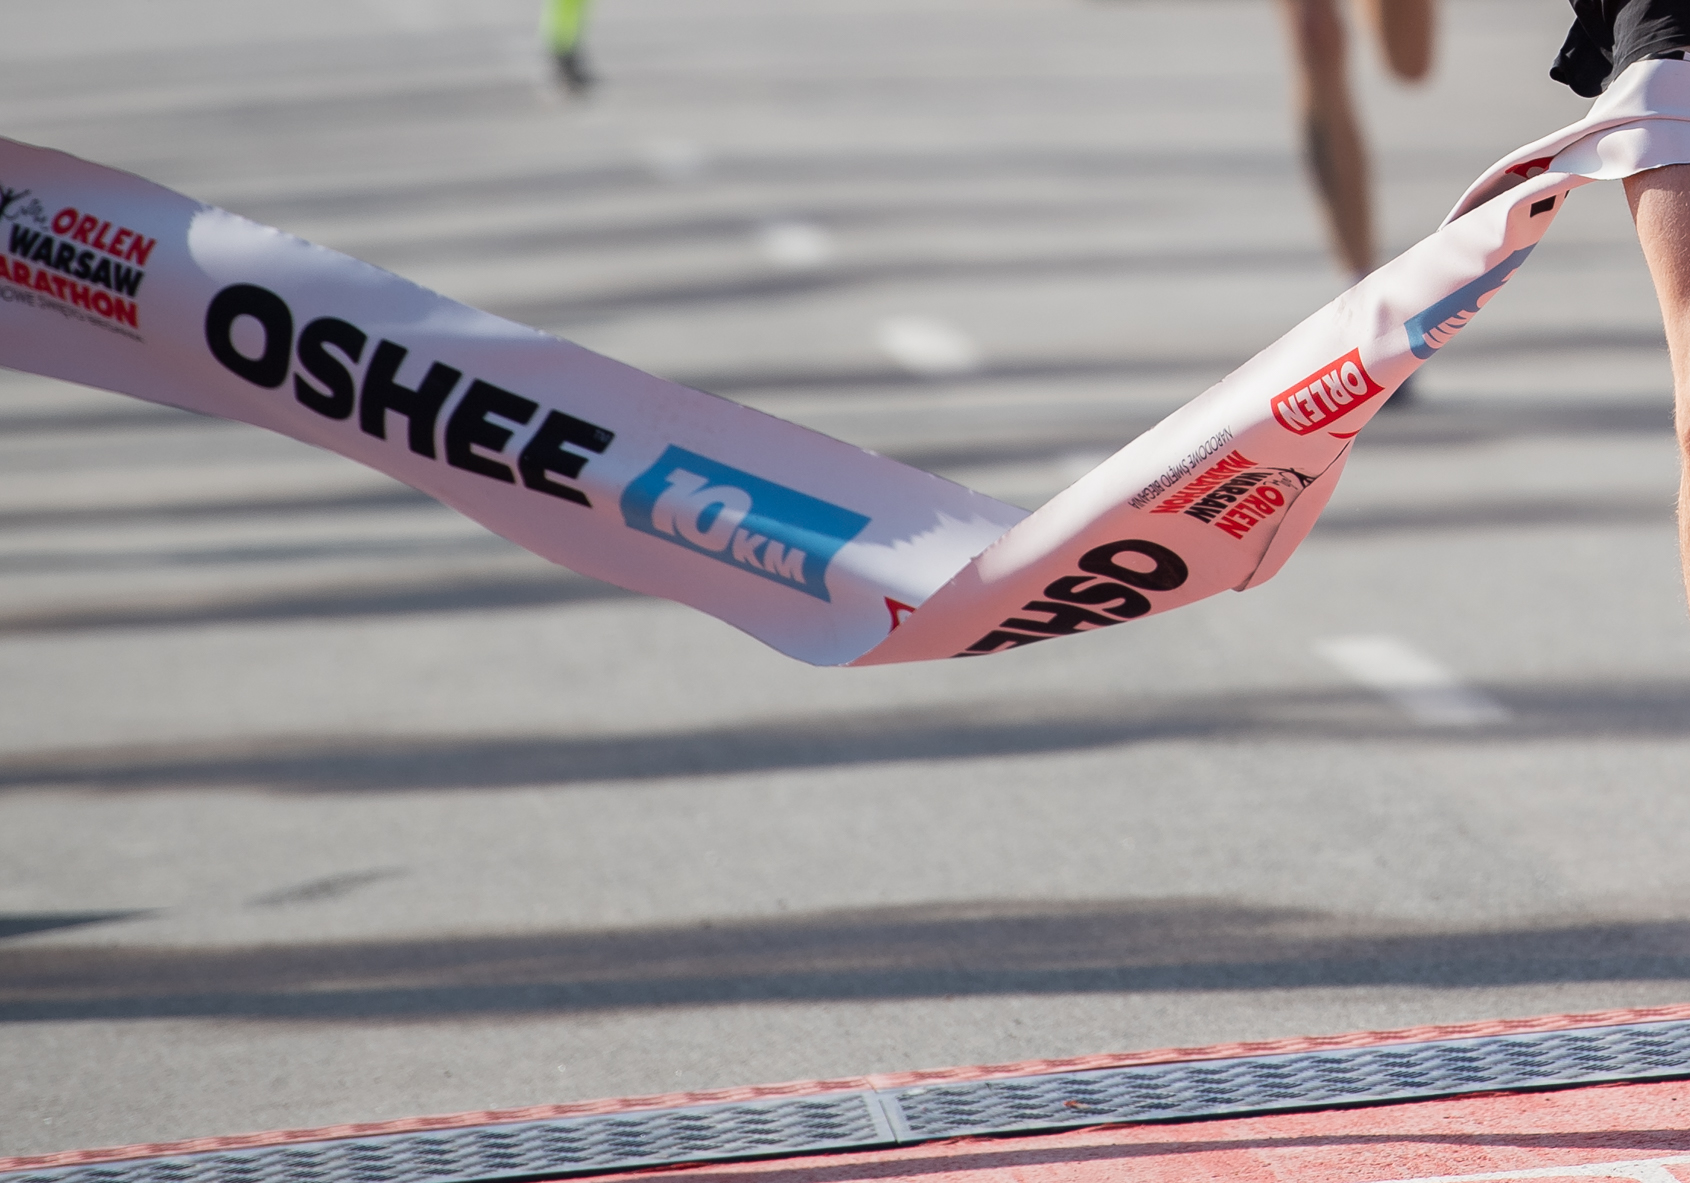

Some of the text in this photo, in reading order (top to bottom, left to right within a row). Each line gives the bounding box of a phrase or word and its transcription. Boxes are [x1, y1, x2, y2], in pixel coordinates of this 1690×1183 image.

[9, 223, 145, 298] WARSAW
[52, 207, 157, 267] ORLEN
[0, 253, 139, 329] ARATHON
[205, 282, 616, 508] OSHEE
[1276, 360, 1368, 432] ORLEN
[1127, 425, 1235, 510] NARODOWE ŚWIĘTO BIEGANIA
[1150, 449, 1259, 514] MARATHON
[1183, 472, 1274, 524] WARSAW
[1214, 485, 1285, 540] ORLEN
